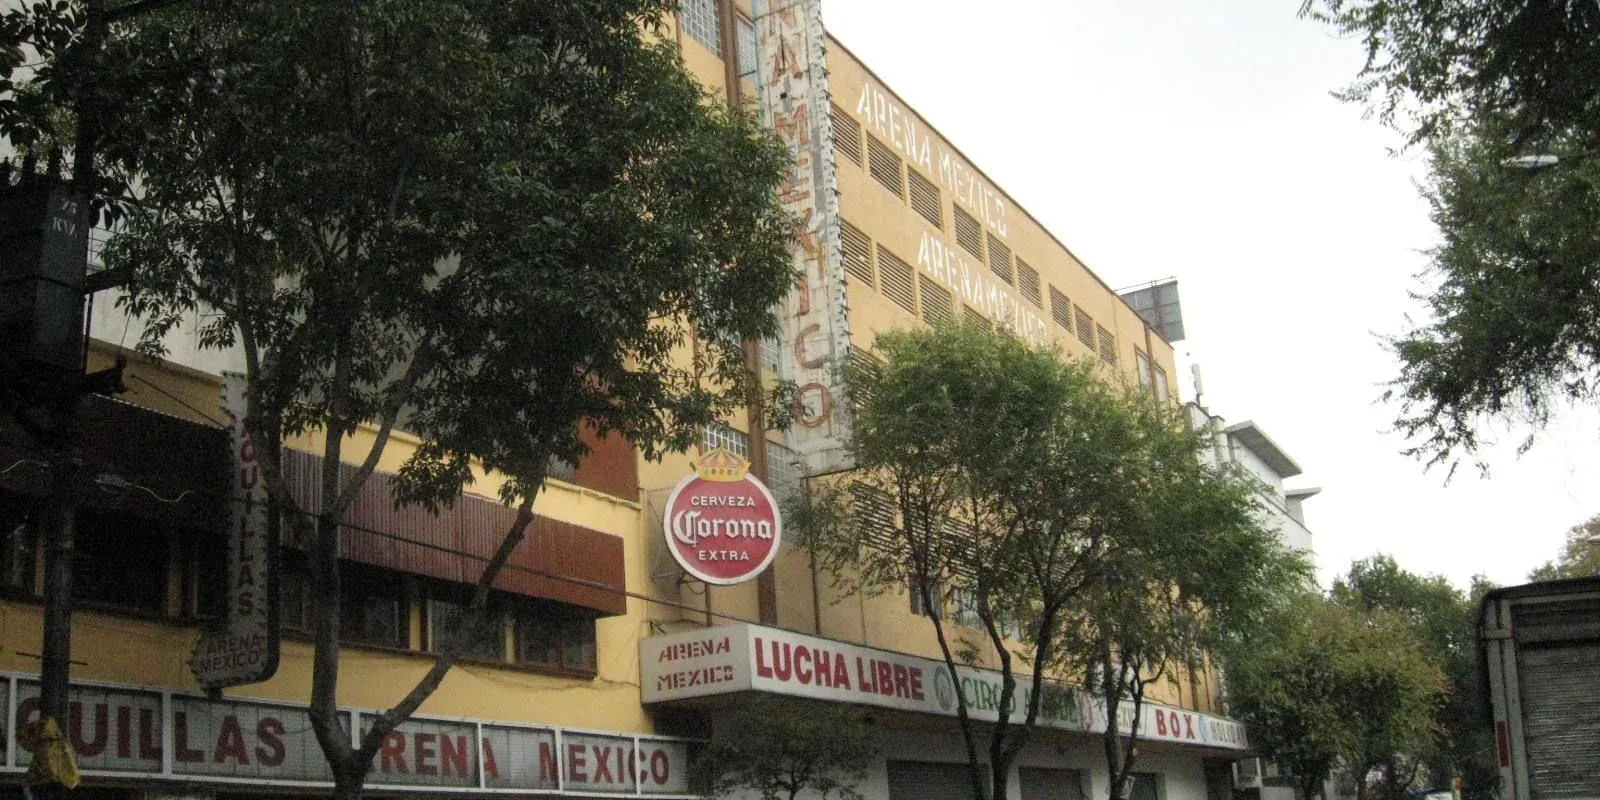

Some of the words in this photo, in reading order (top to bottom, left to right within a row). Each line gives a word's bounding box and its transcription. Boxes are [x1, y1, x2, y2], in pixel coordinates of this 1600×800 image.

[856, 82, 932, 173] ARENA
[938, 145, 1008, 238] MEXICO
[917, 231, 985, 309] ARENA
[690, 495, 756, 507] CERVEZA
[672, 510, 773, 547] Corona
[698, 550, 749, 561] EXTRA
[207, 635, 261, 655] ARENA
[658, 637, 731, 663] ARENA
[200, 650, 261, 673] MEXICO
[754, 637, 852, 690] LUCHA
[856, 657, 925, 701] LIBRE
[657, 665, 734, 691] MEXICO
[1155, 709, 1196, 740] BOX
[360, 727, 499, 779] RENA
[539, 743, 670, 785] MEXICO
